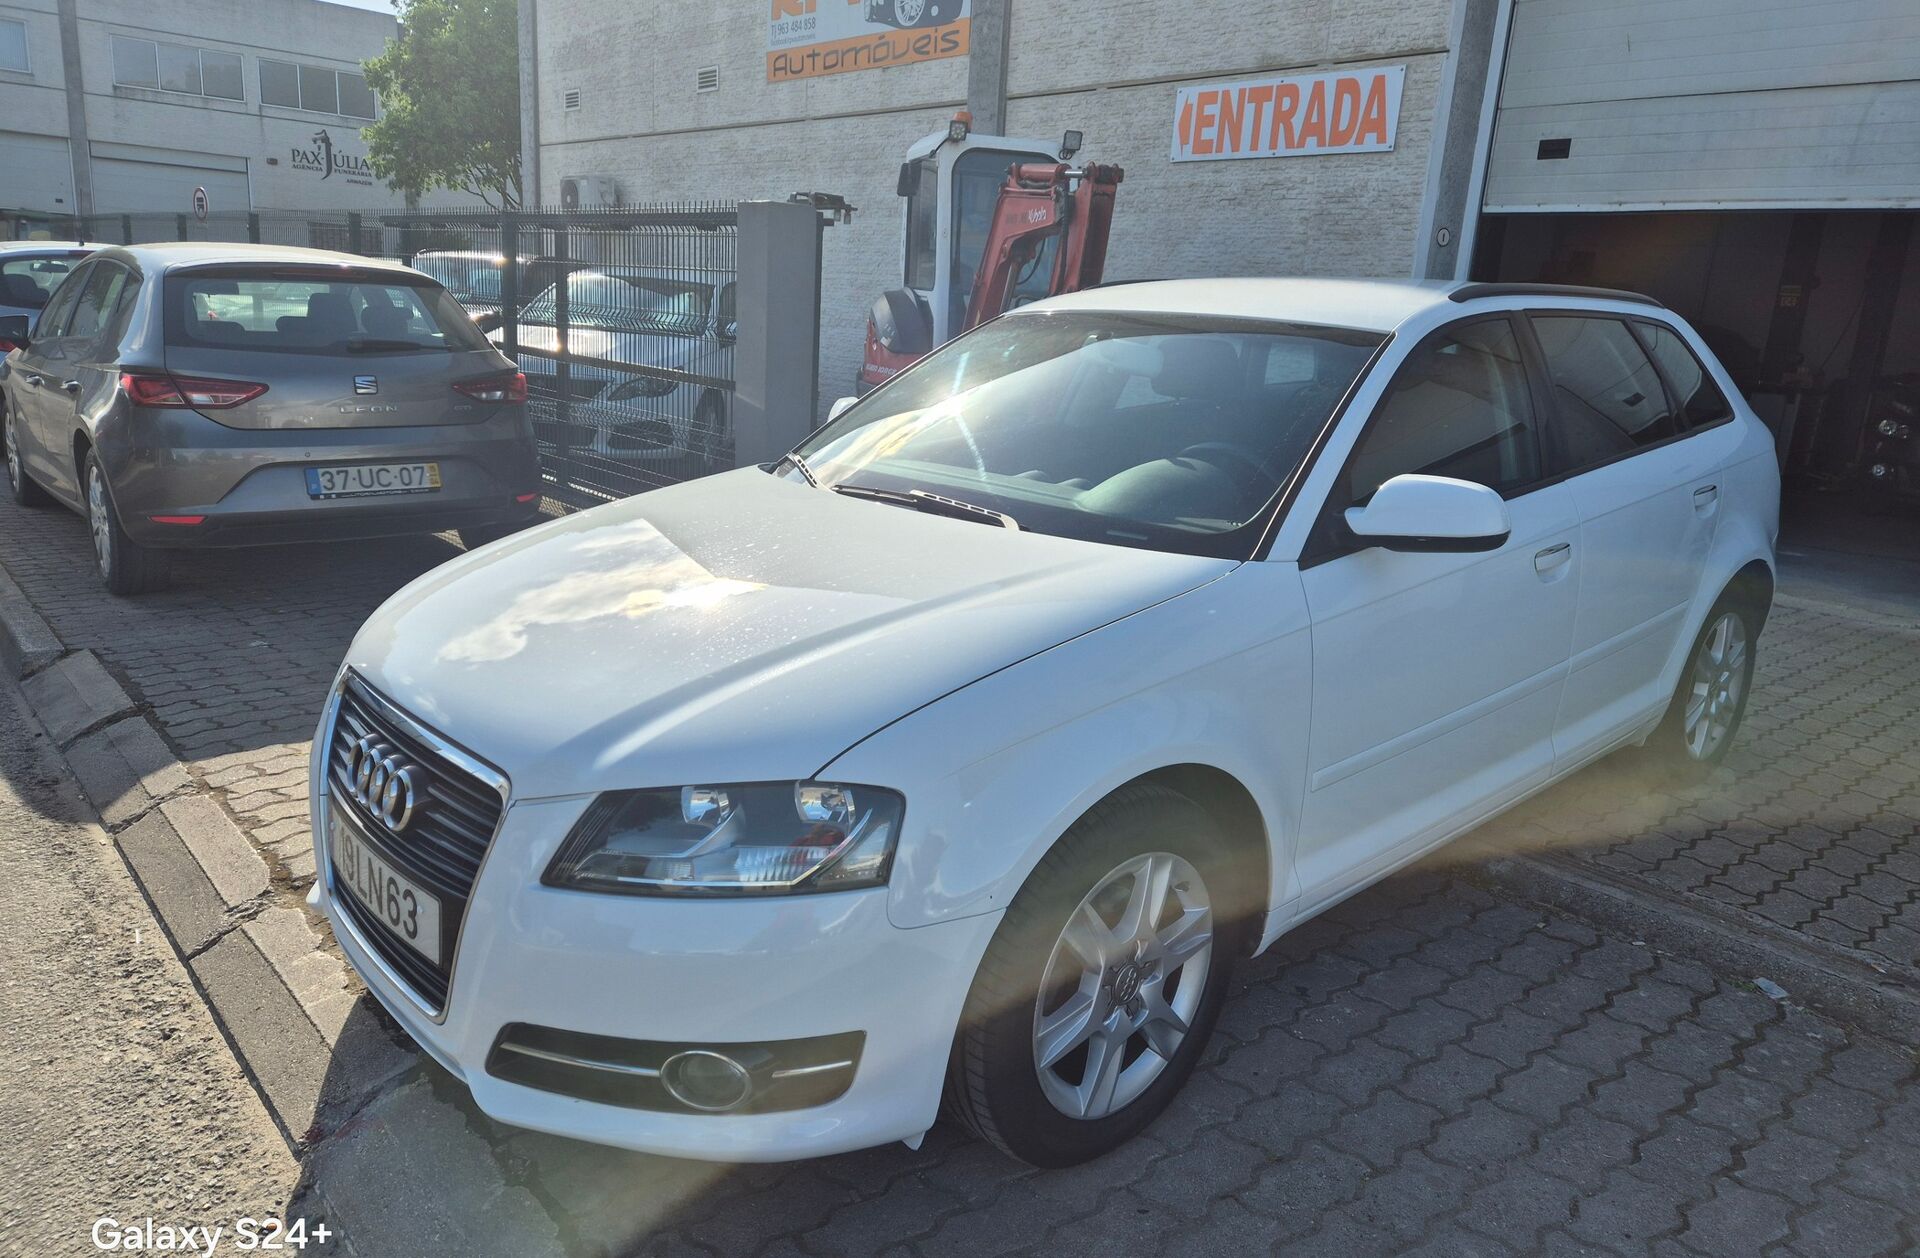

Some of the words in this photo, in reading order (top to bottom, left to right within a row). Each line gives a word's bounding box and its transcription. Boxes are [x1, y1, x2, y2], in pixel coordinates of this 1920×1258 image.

[778, 22, 789, 35] 963
[791, 19, 802, 32] 484
[803, 17, 816, 31] 858
[773, 27, 960, 78] Automóveis
[1192, 74, 1387, 155] ENTRADA
